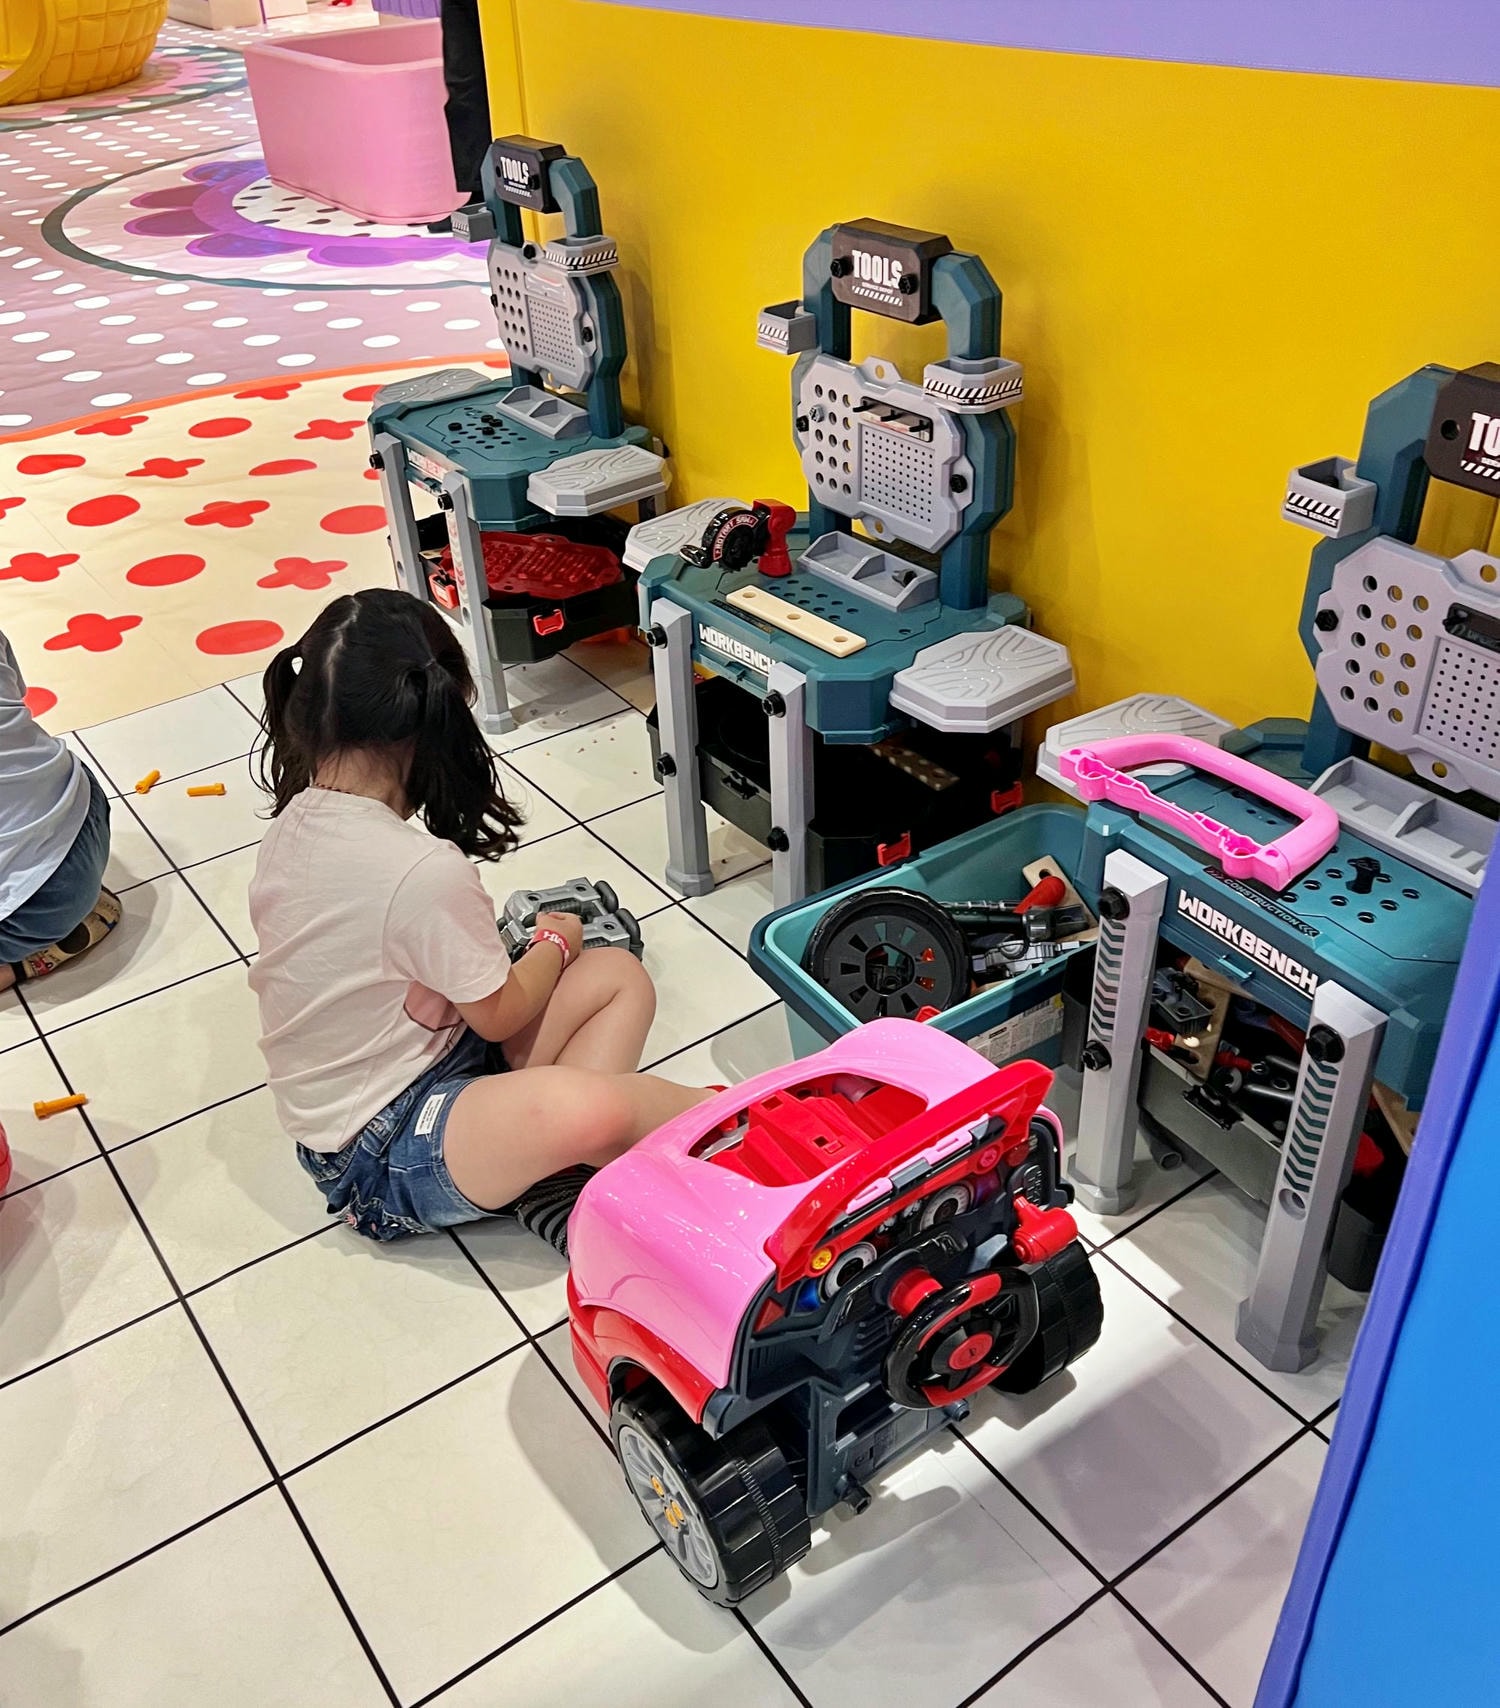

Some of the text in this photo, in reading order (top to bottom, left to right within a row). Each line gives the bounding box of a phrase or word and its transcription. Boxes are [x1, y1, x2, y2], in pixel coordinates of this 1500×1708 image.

[500, 156, 529, 185] TOOLS
[851, 249, 903, 289] TOOLS
[1178, 888, 1319, 996] WORKBENCH
